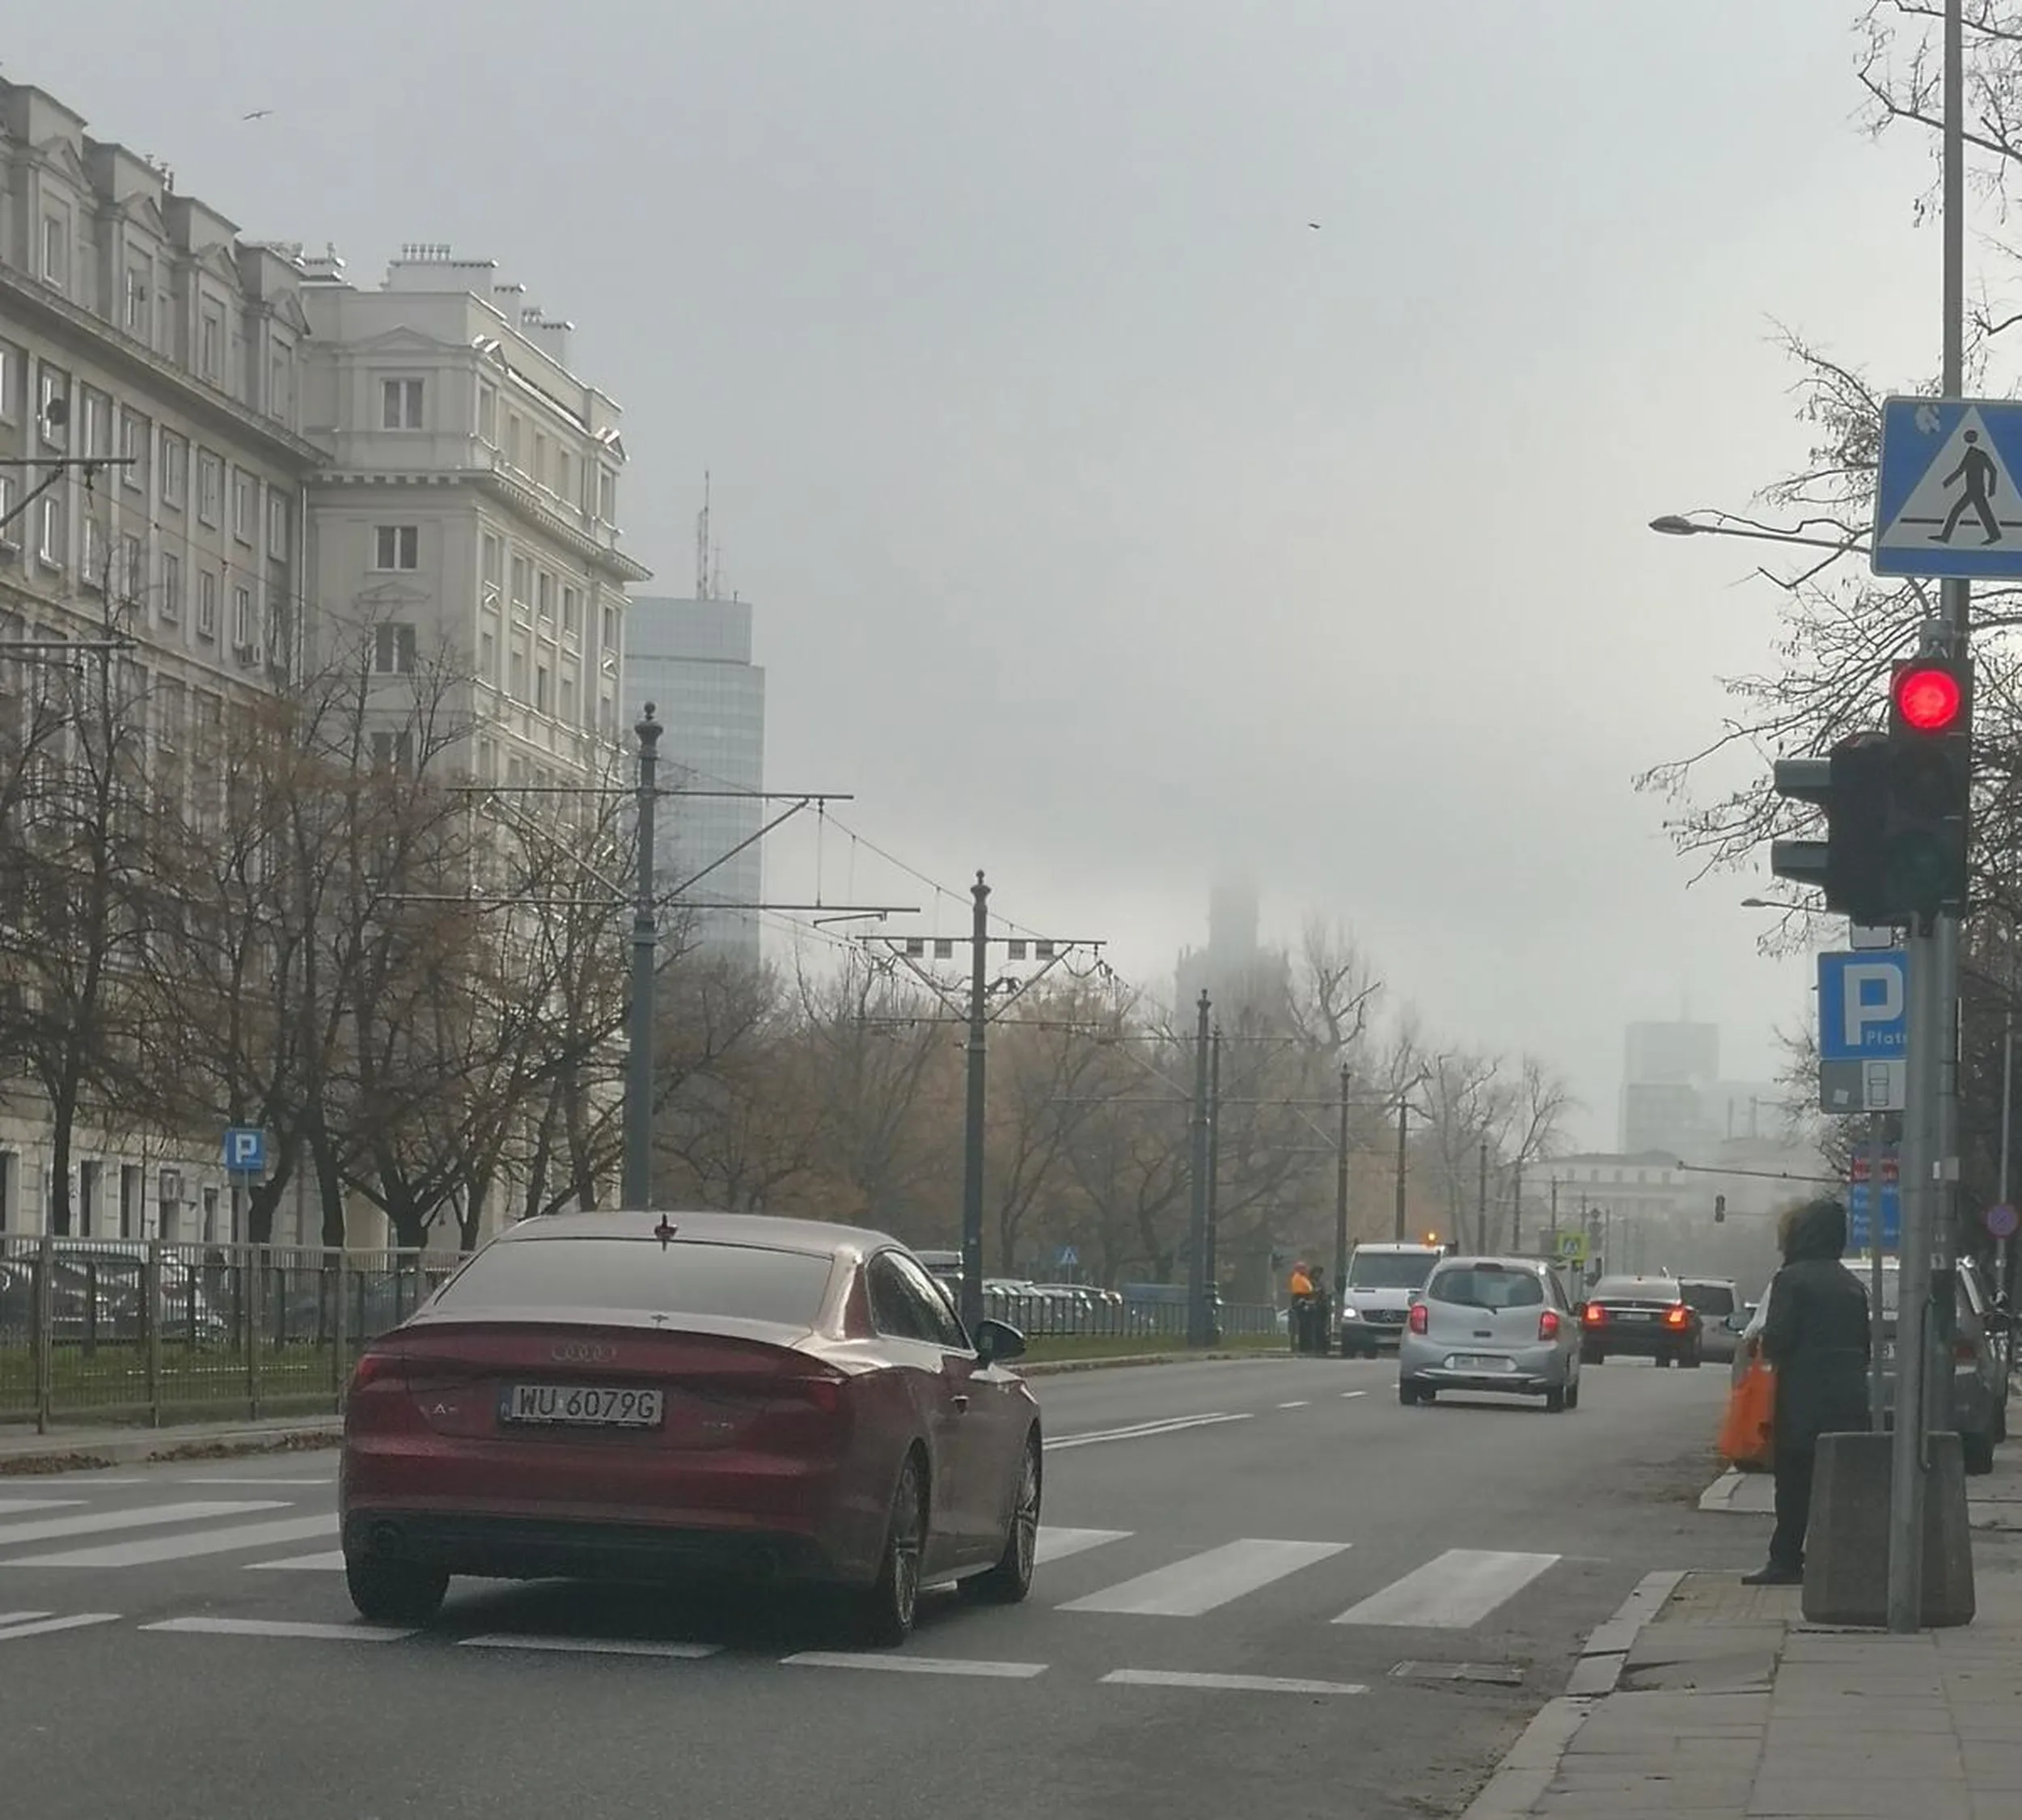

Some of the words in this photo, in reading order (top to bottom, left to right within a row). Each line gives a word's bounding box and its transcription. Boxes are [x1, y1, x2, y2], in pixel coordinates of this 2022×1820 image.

[1844, 963, 1904, 1045] P
[235, 1133, 257, 1164] P
[520, 1387, 557, 1416] WU
[566, 1389, 655, 1418] 6079G
